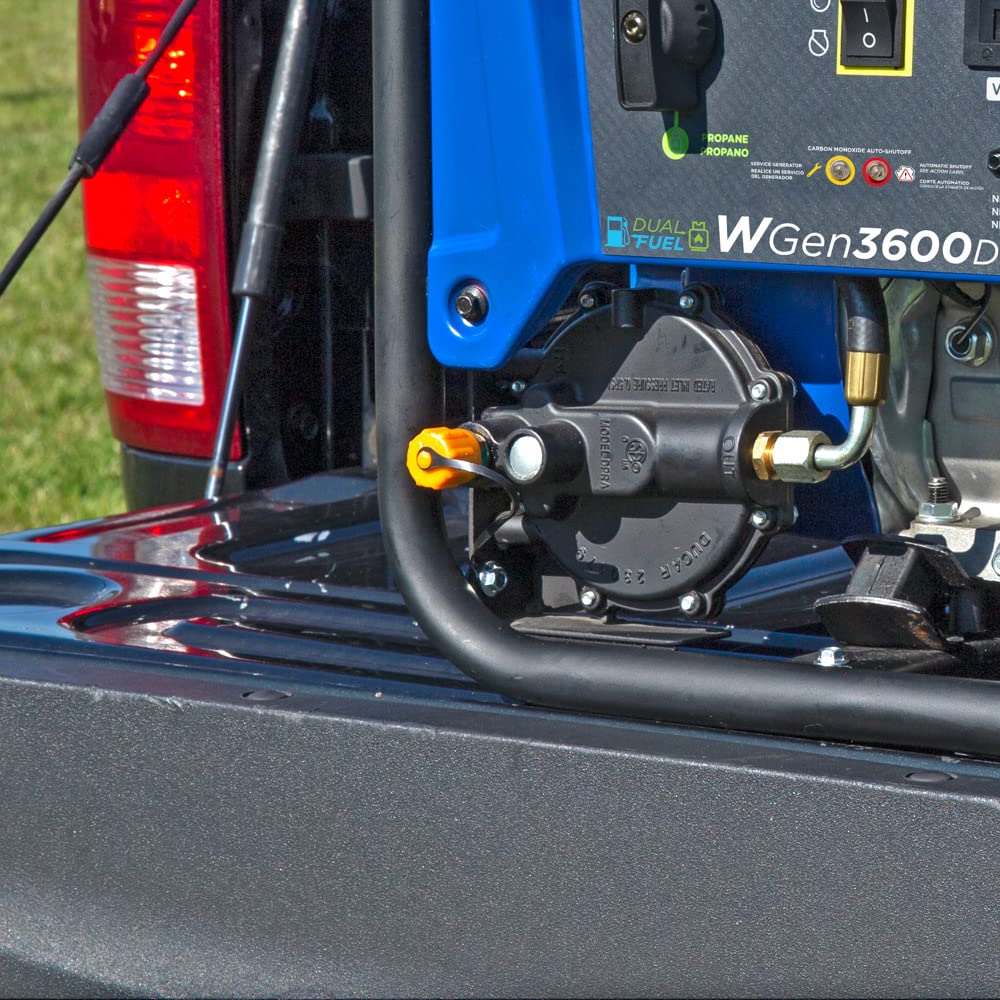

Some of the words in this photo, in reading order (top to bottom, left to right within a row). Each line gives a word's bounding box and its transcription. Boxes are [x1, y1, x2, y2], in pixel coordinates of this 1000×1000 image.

[632, 217, 685, 235] DUAL
[632, 234, 684, 251] FUEL
[599, 419, 610, 457] MODEL
[659, 530, 712, 580] DUCAR
